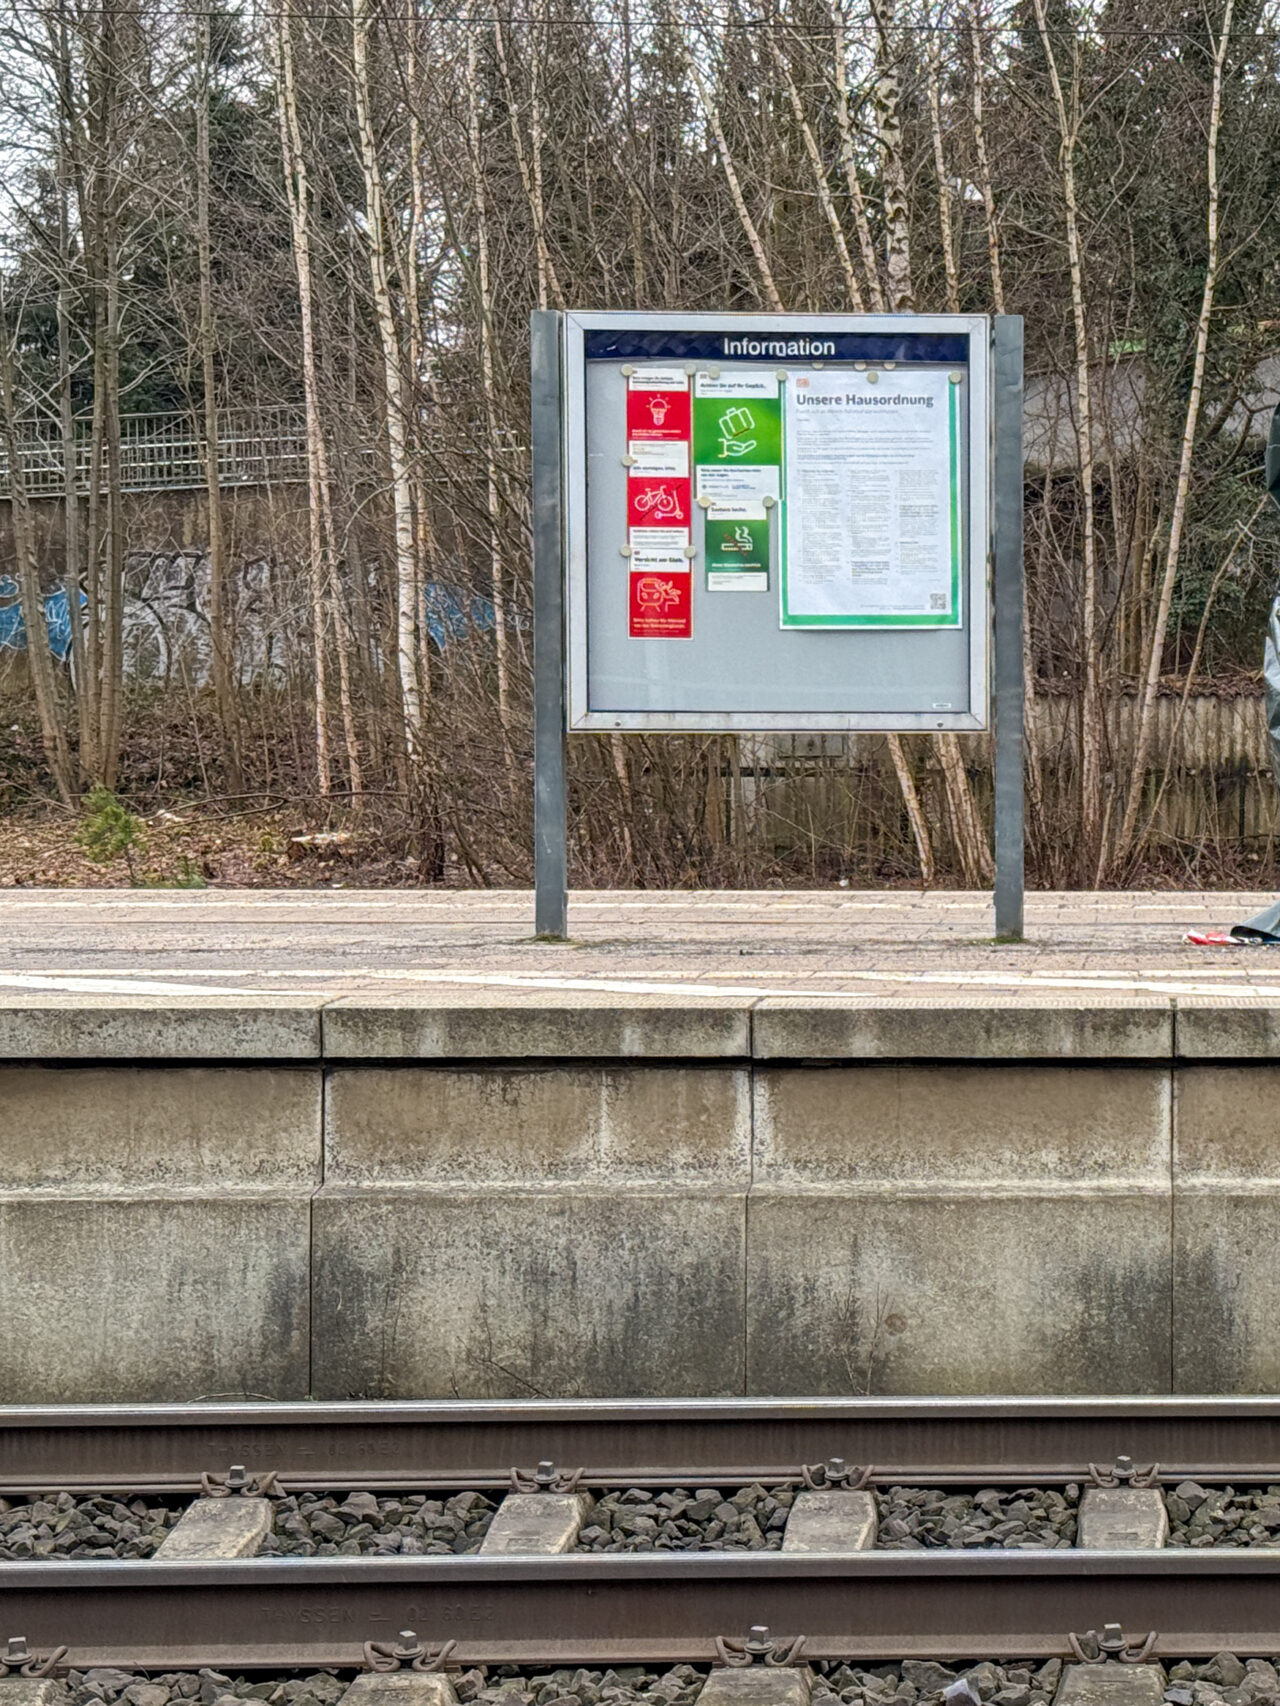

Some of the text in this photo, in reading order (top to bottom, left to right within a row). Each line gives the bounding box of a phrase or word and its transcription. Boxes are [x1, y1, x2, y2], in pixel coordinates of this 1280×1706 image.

[724, 337, 835, 356] Information
[796, 394, 934, 408] Unsere Hausordnung
[261, 1607, 355, 1623] THYSSEN
